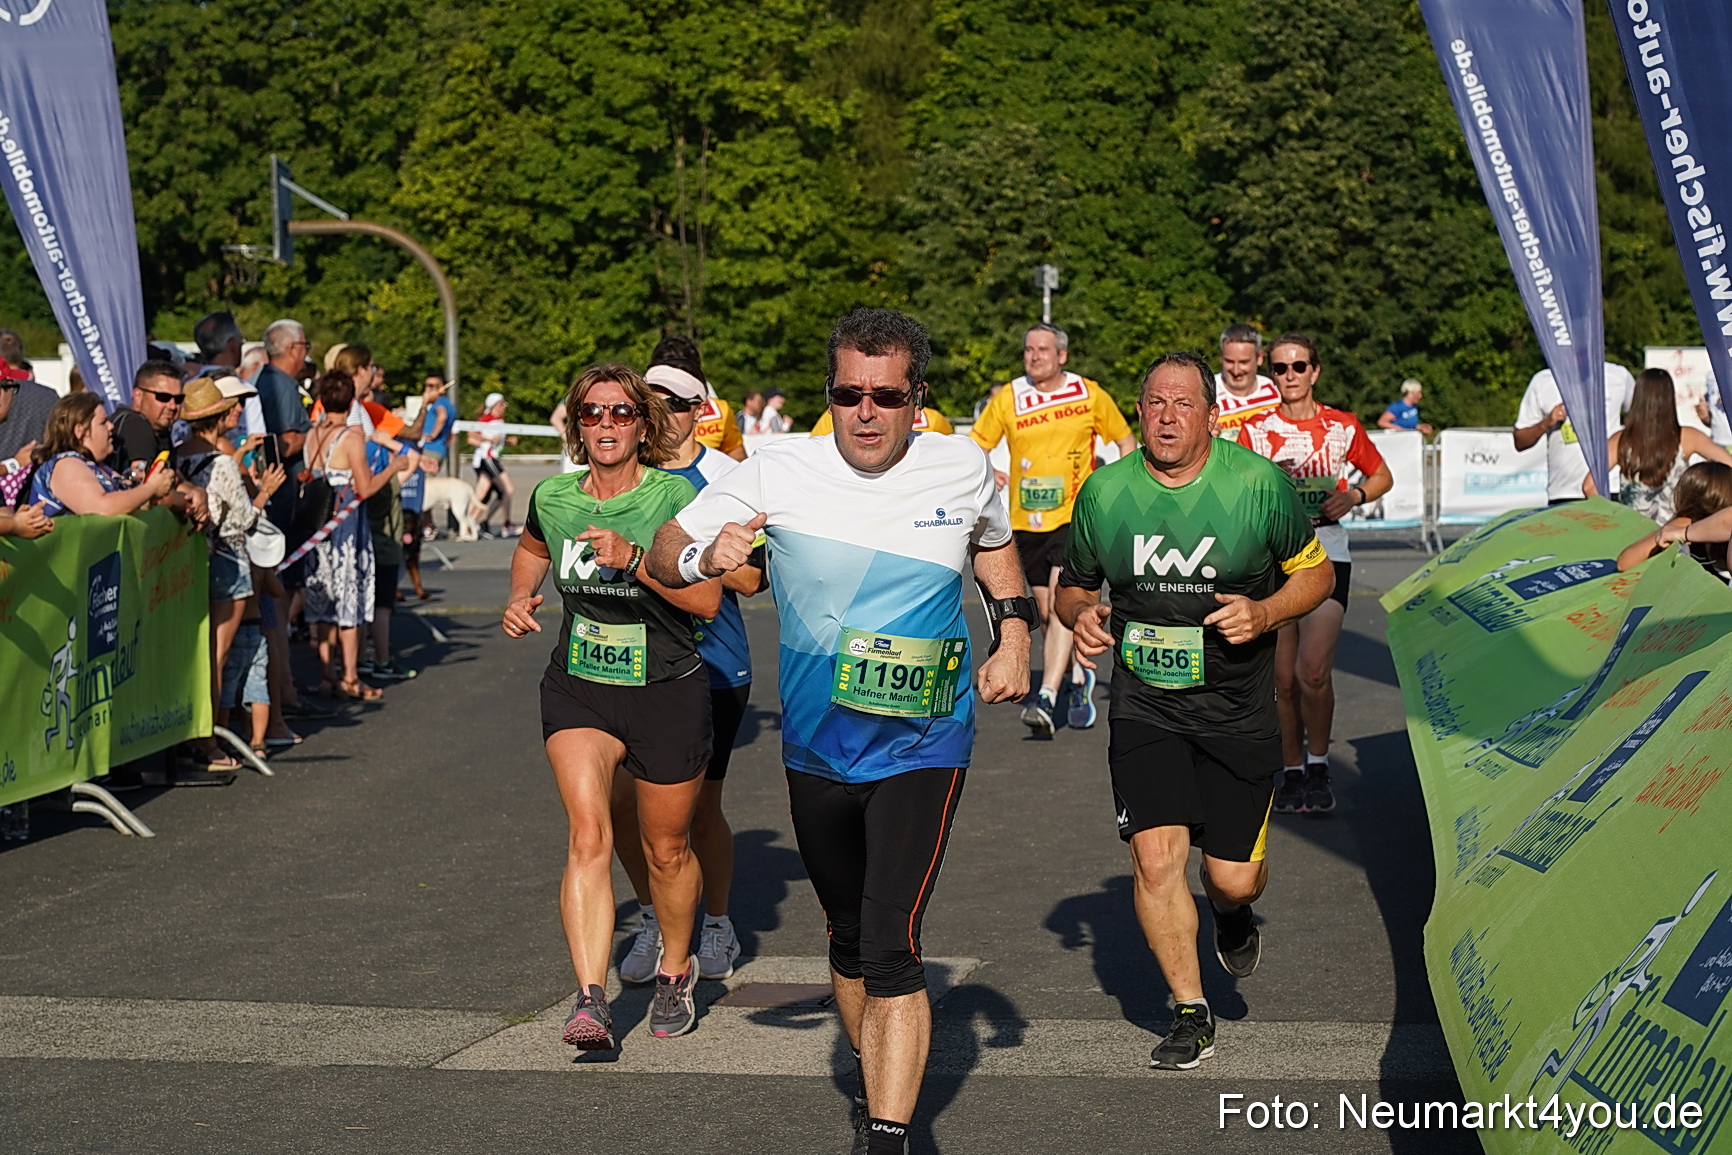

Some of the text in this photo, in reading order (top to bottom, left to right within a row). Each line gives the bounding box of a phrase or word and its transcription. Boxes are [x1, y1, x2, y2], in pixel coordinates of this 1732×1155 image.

[1016, 403, 1092, 430] MAX BÖGL
[694, 423, 722, 438] ÖGL
[1025, 488, 1057, 500] 1627
[914, 518, 963, 528] SCHABMÜLLER
[561, 585, 639, 597] KW ENERGIE
[1136, 582, 1215, 593] KW ENERGIE
[571, 643, 579, 665] RUN
[580, 640, 632, 666] 1464
[868, 647, 902, 657] Firmenlauf
[1134, 646, 1189, 669] 1456
[579, 660, 601, 672] Pfaller
[601, 664, 631, 675] Martina
[633, 649, 643, 678] 2022
[1134, 665, 1192, 678] Wangelin Joachim
[1191, 652, 1200, 680] 2022
[838, 663, 852, 691] RUN
[855, 659, 925, 691] 1190
[853, 686, 918, 703] Hafner Martin
[922, 670, 935, 706] 2022
